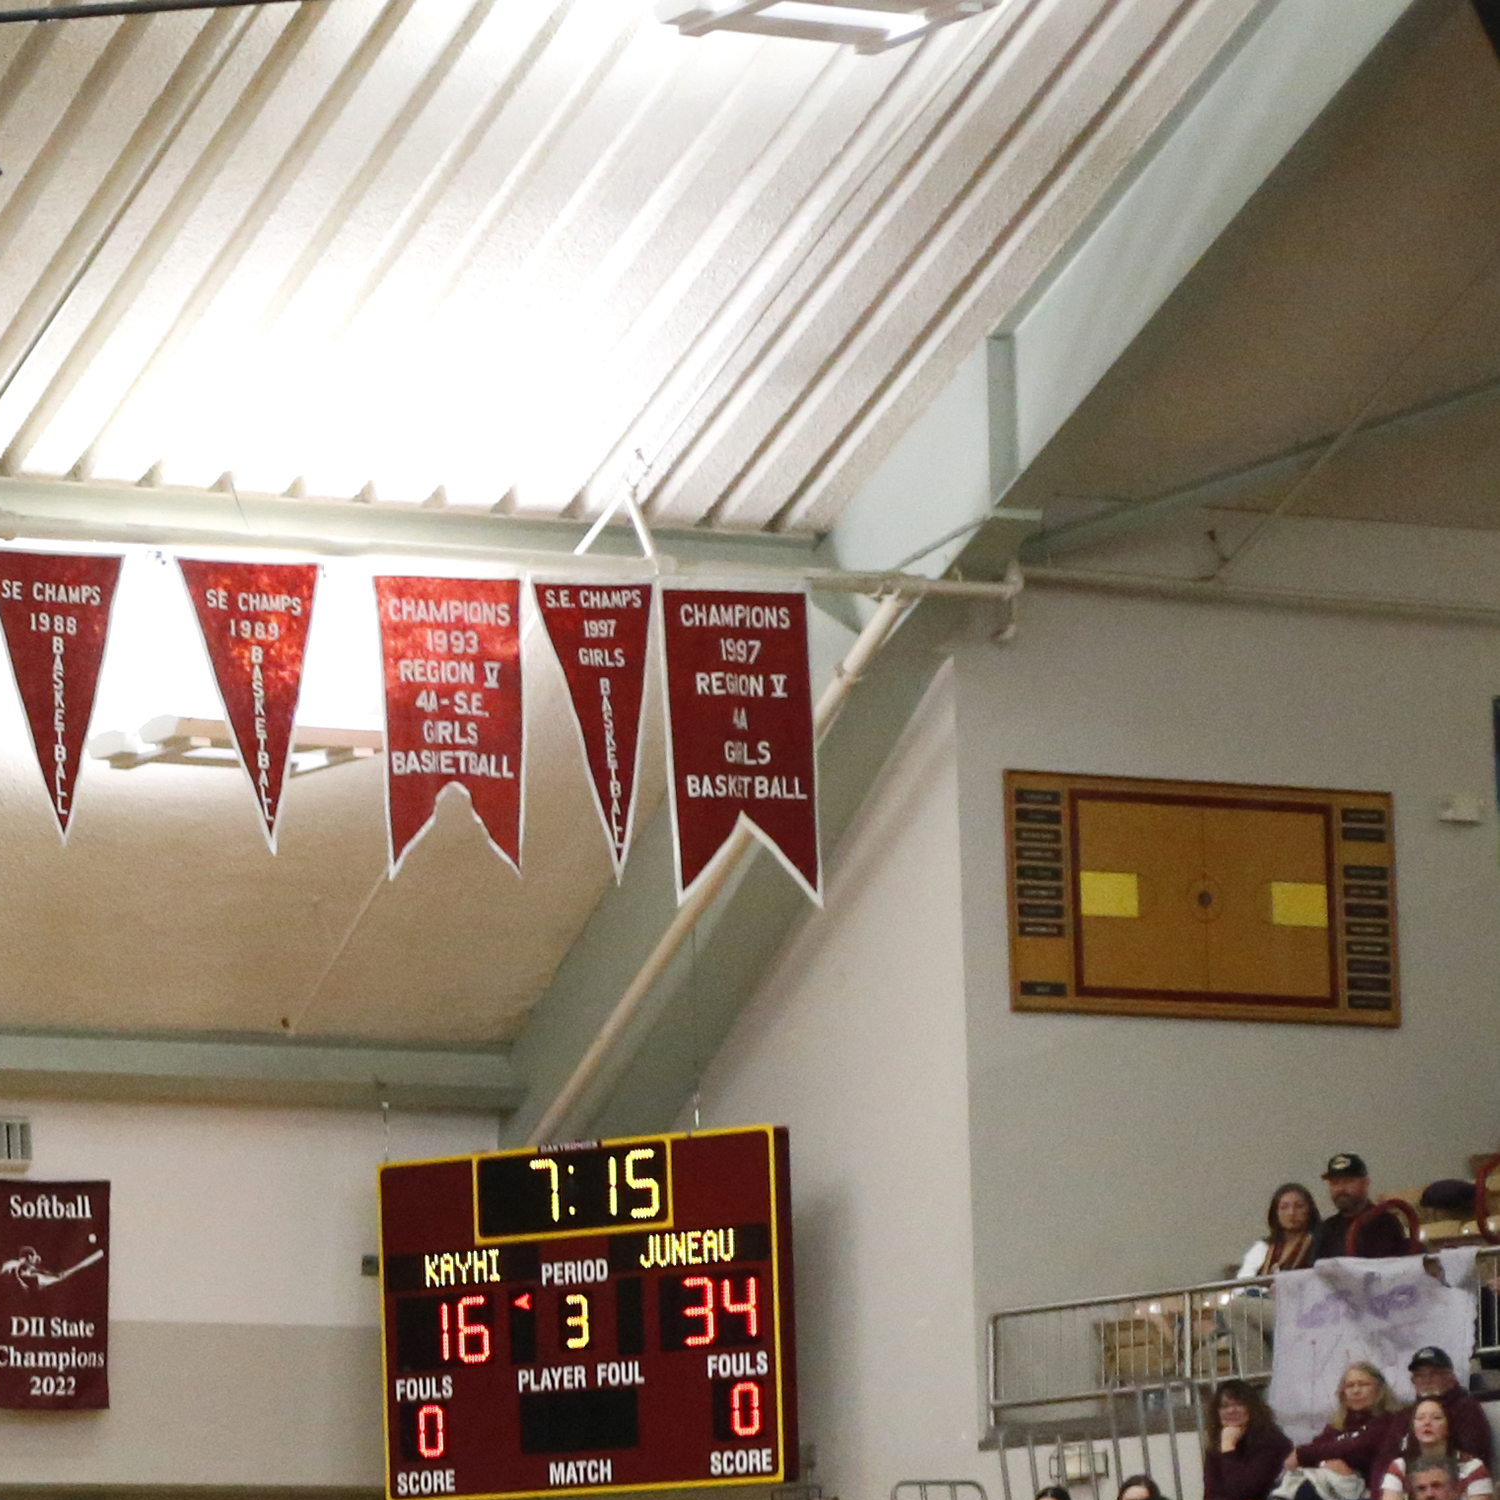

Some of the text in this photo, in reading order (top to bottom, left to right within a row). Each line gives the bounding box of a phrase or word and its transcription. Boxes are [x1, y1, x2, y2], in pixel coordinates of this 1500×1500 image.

[32, 581, 101, 606] CHAMPS
[237, 592, 301, 617] CHAMPS
[579, 590, 642, 608] CHAMPS
[389, 598, 511, 626] CHAMPIONS
[680, 604, 791, 629] CHAMPIONS
[426, 628, 479, 654] 1993
[583, 619, 617, 638] 1997
[578, 648, 625, 667] GIRLS
[399, 658, 475, 684] REGION
[696, 672, 764, 697] REGION
[529, 1149, 660, 1222] 7:15
[10, 1195, 92, 1219] Softball
[639, 1227, 735, 1268] JUNEAU
[423, 1248, 501, 1287] KAYHI
[541, 1258, 609, 1286] PERIOD
[566, 1294, 589, 1349] 3
[683, 1276, 757, 1347] 34
[51, 1317, 94, 1338] State
[441, 1295, 490, 1362] 16
[518, 1361, 645, 1392] PLAYER FOUL
[707, 1351, 768, 1378] FOULS
[30, 1377, 76, 1395] 2022
[395, 1376, 453, 1401] FOULS
[732, 1382, 759, 1436] 0
[418, 1405, 443, 1457] 0
[549, 1459, 612, 1485] MATCH
[710, 1448, 773, 1475] SCORE
[397, 1470, 455, 1495] SCORE
